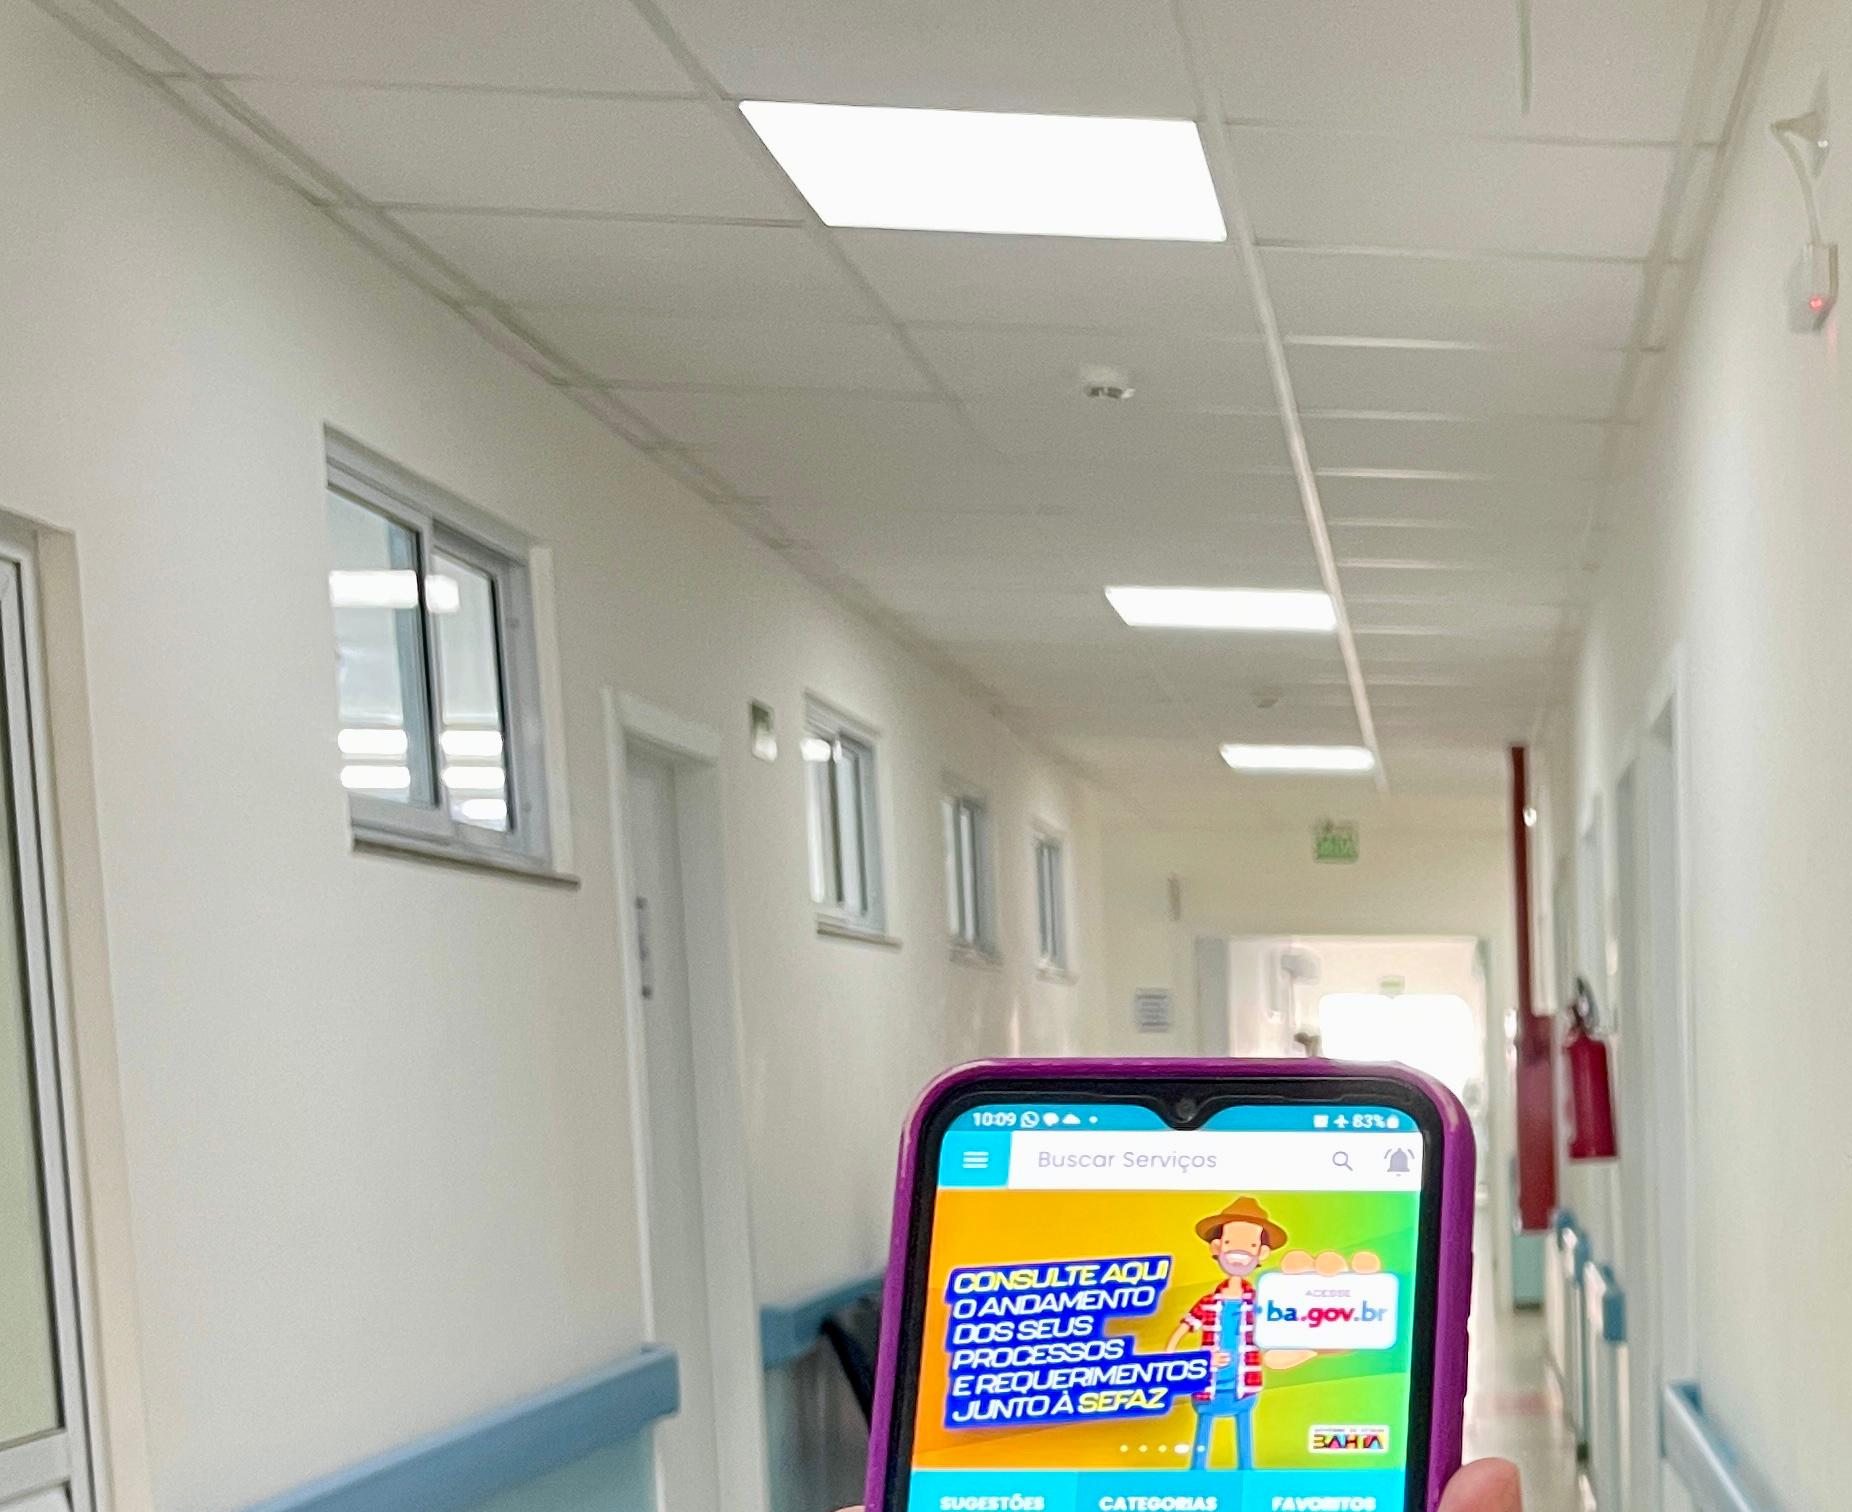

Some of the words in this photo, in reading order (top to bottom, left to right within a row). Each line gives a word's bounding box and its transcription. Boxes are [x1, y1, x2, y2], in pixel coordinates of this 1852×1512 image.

[972, 1112, 1017, 1127] 10:09
[1352, 1113, 1386, 1129] 83%
[1037, 1151, 1114, 1168] Buscar
[1122, 1150, 1217, 1173] Serviços
[953, 1264, 1101, 1294] CONSULTE
[1101, 1260, 1169, 1285] AQUI
[952, 1298, 977, 1319] O
[978, 1286, 1155, 1318] ANDAMENTO
[1266, 1299, 1388, 1329] ba.gov.br
[952, 1320, 1014, 1345] DOS
[1016, 1315, 1094, 1340] SEUS
[952, 1338, 1126, 1370] PROCESSOS
[952, 1375, 975, 1397] E
[975, 1359, 1208, 1395] REQUERIMENTOS
[952, 1394, 1051, 1422] JUNTO
[1051, 1390, 1075, 1415] À
[1077, 1387, 1169, 1413] SEFAZ
[1312, 1433, 1384, 1450] BAHIA
[939, 1493, 1045, 1512] SUGESTÕES
[1098, 1495, 1218, 1512] CATEGORIAS
[1271, 1496, 1378, 1512] FAVORITOS
